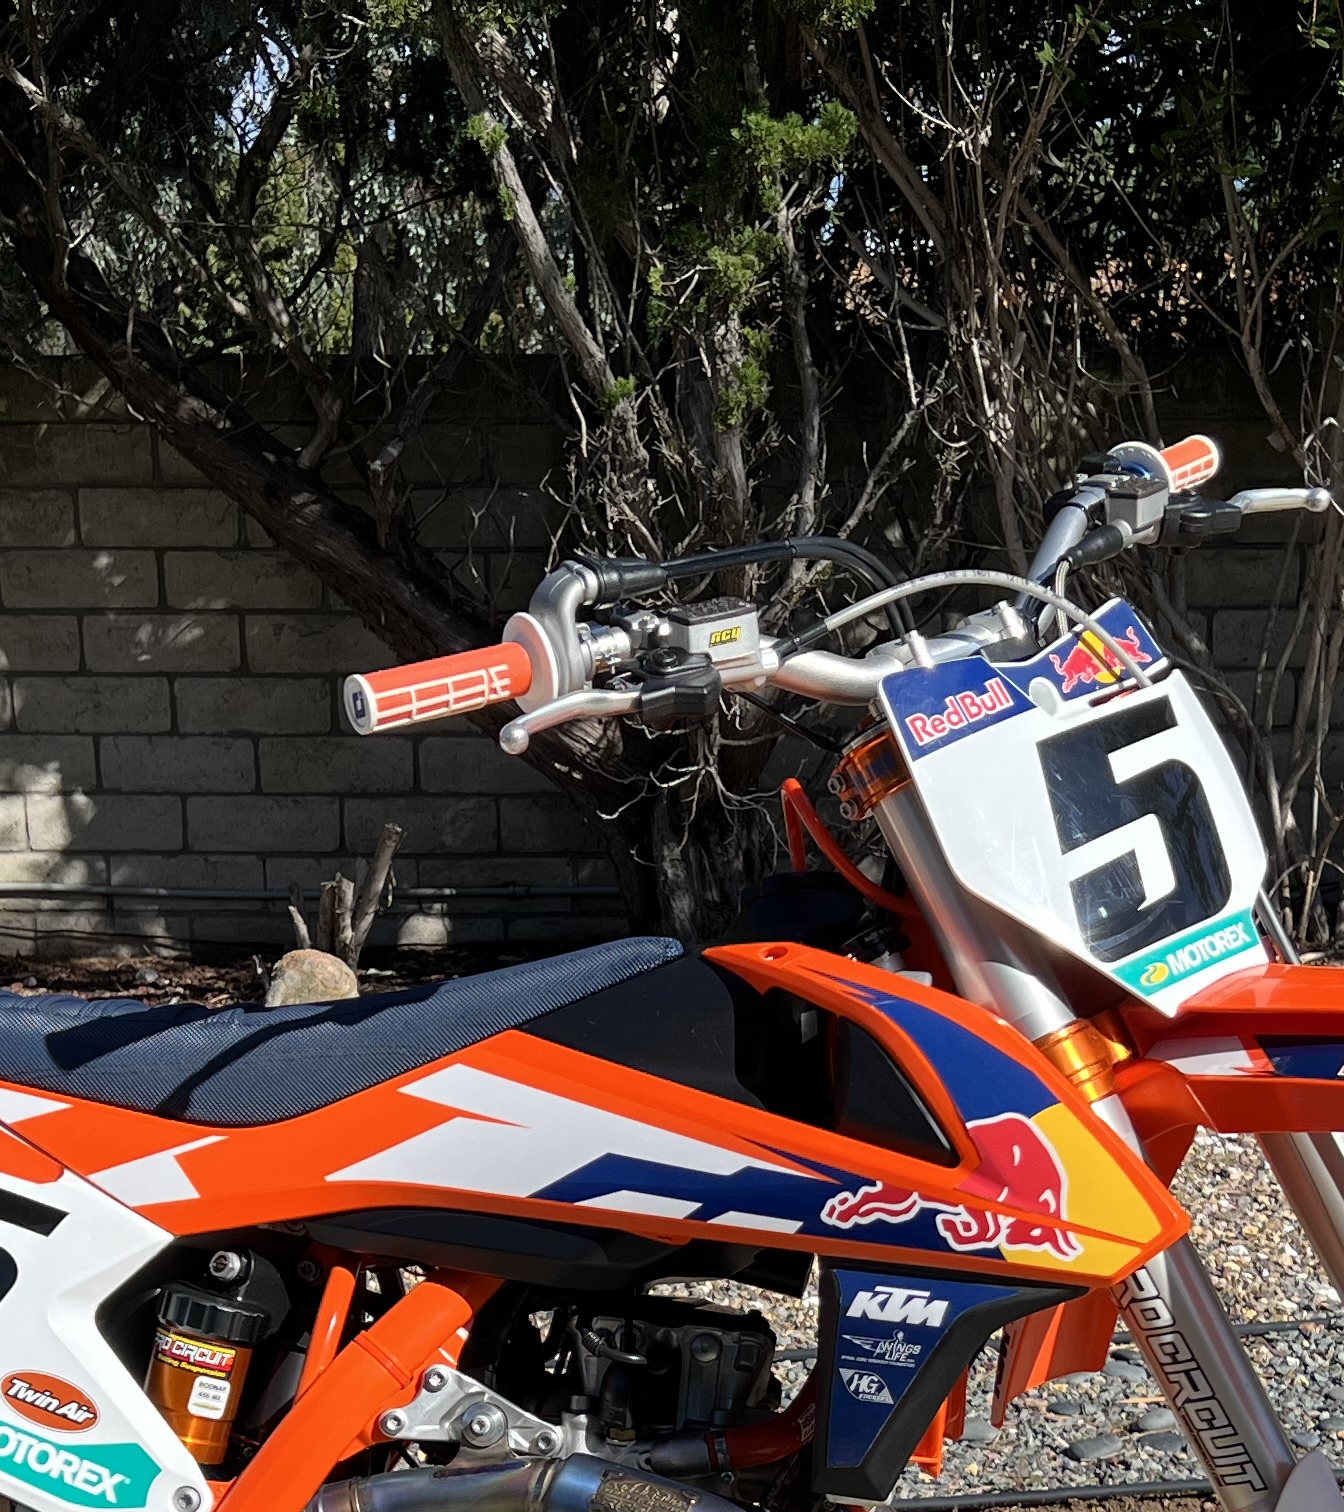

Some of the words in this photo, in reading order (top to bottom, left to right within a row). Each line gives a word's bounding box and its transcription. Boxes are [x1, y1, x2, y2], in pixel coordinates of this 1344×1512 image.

[908, 699, 965, 746] Red
[960, 677, 1014, 726] Bull
[1035, 694, 1232, 964] 5
[1168, 920, 1251, 977] MOTOREX
[846, 1285, 949, 1327] KTM
[171, 1340, 233, 1367] CIRCUIT
[1112, 1266, 1176, 1331] RO
[1145, 1330, 1269, 1492] CIRCUIT
[6, 1379, 56, 1415] Twin
[55, 1398, 96, 1426] Air
[849, 1373, 881, 1394] HG
